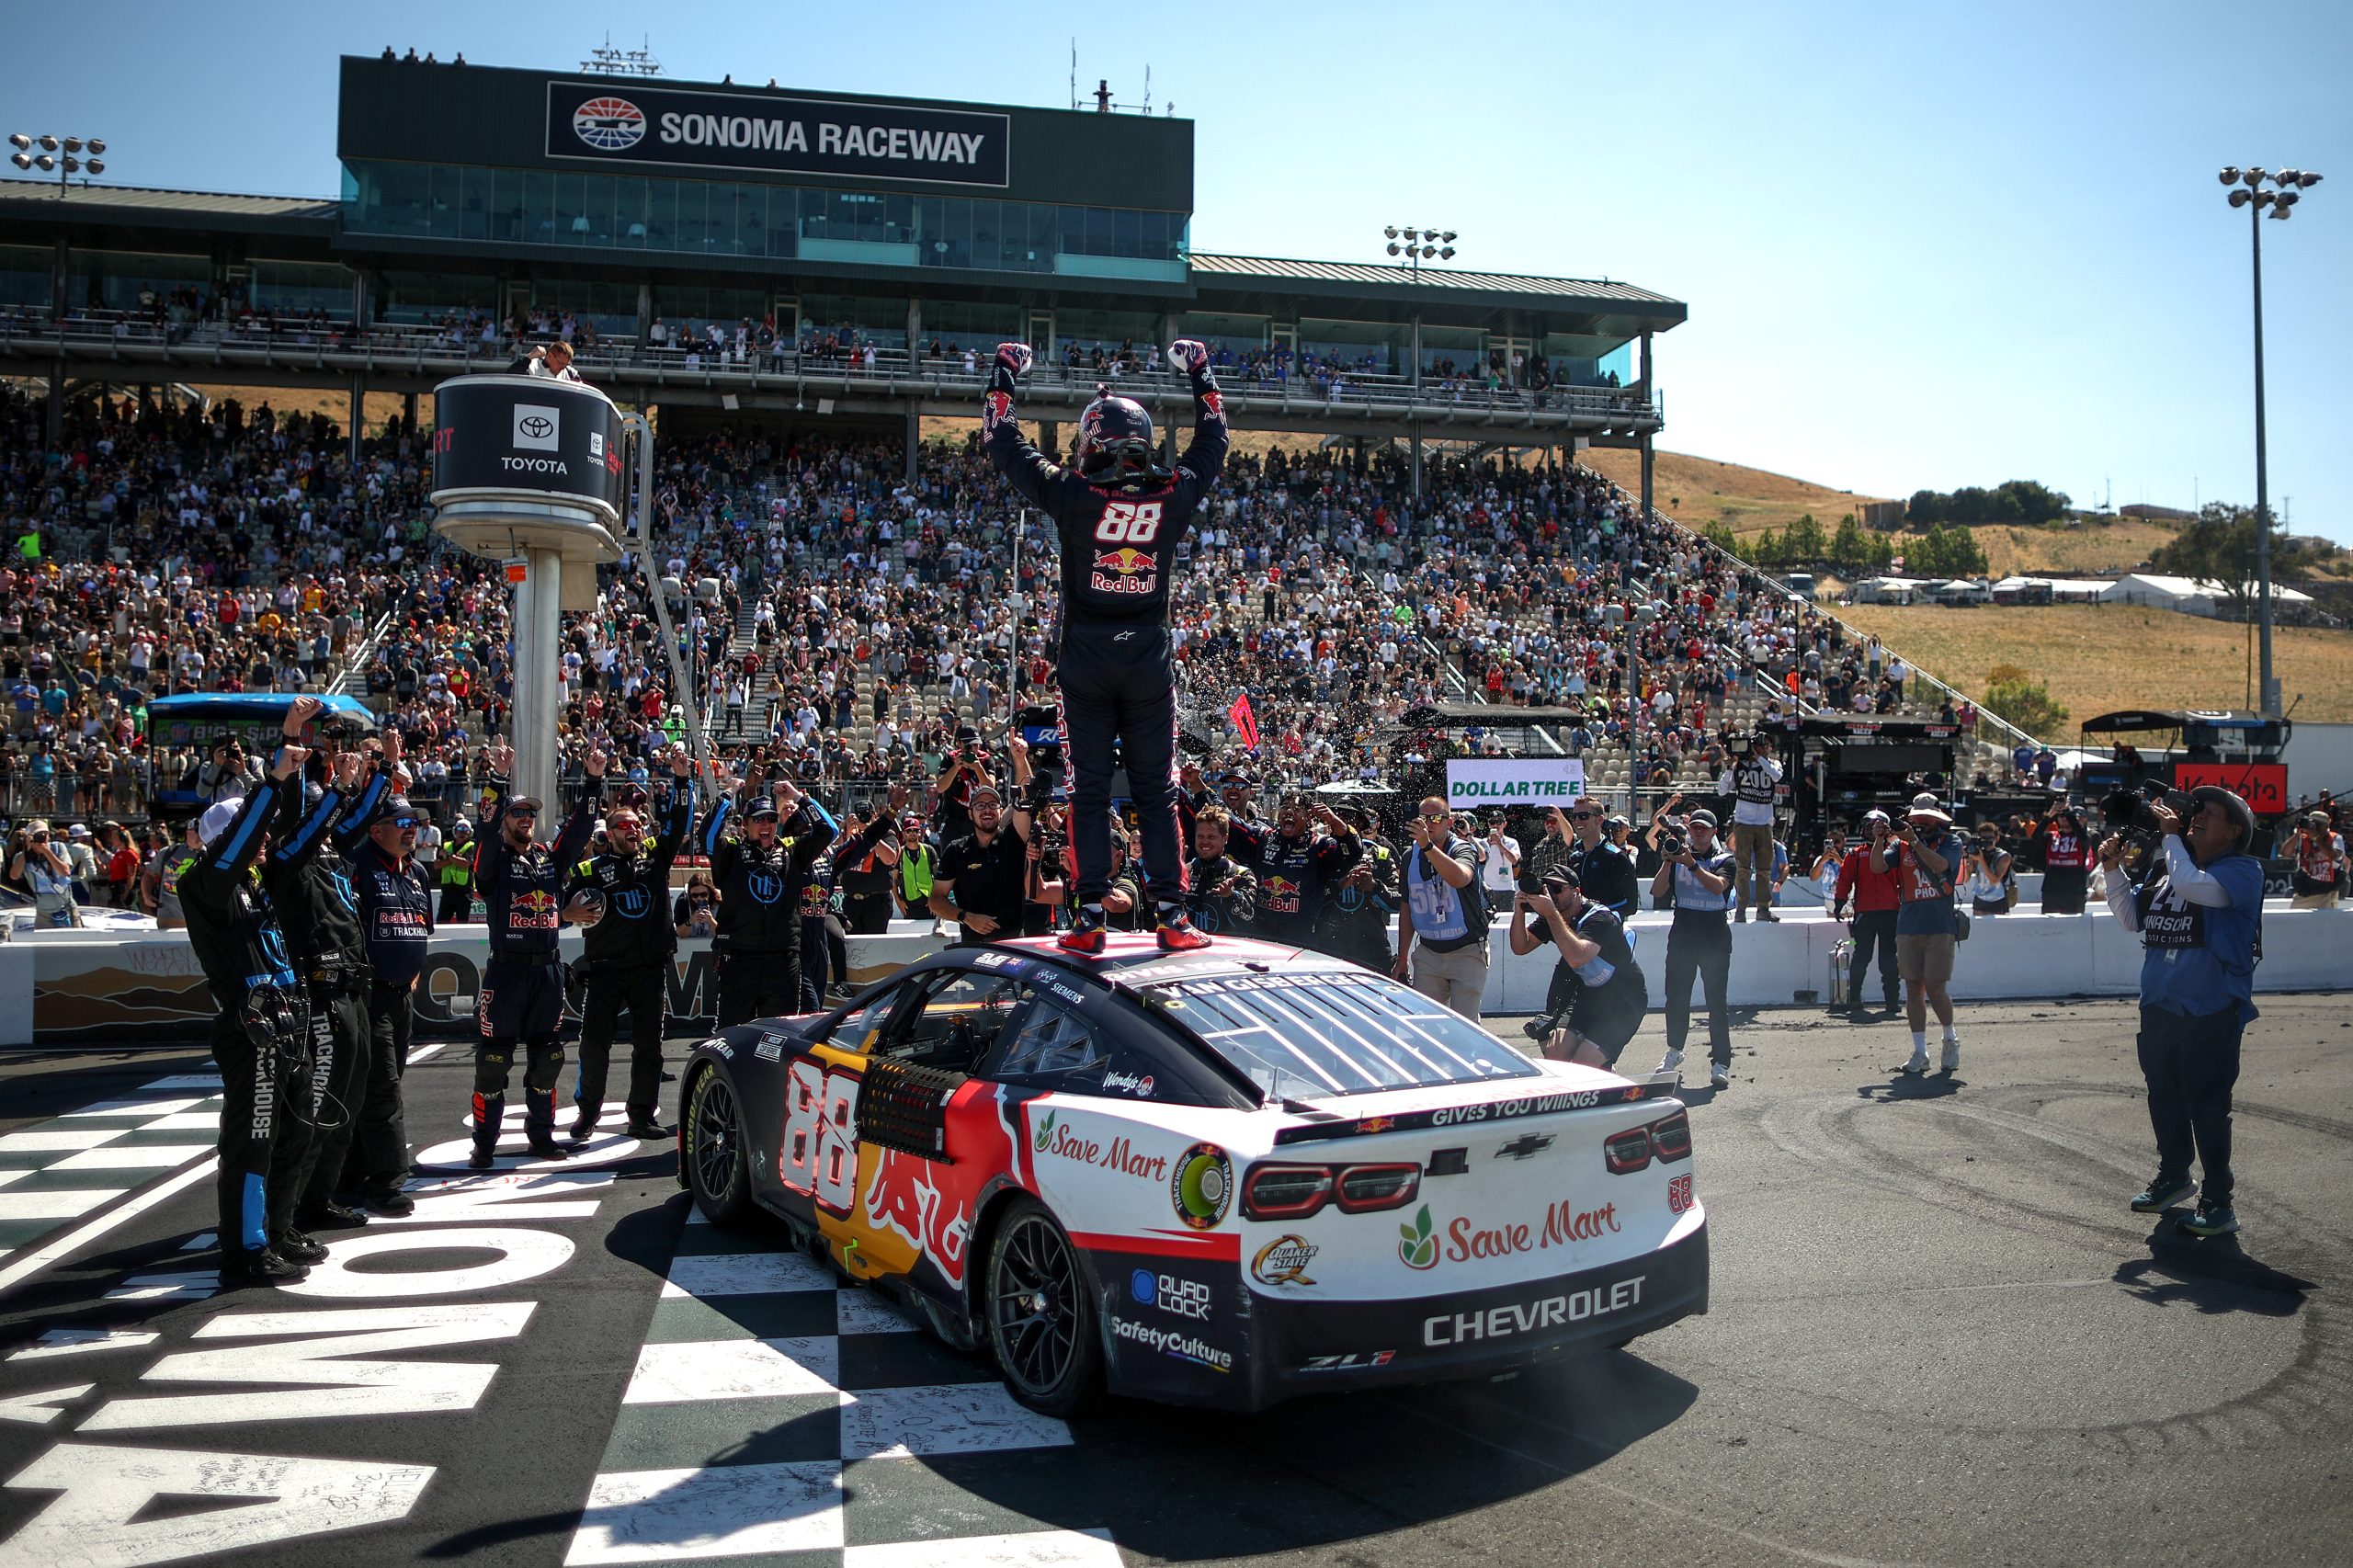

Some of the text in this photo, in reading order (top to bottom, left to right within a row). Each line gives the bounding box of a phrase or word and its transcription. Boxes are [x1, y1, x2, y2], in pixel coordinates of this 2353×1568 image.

[660, 110, 984, 165] SONOMA RACEWAY
[501, 457, 568, 475] TOYOTA
[587, 455, 604, 467] TOYOTA
[1094, 500, 1164, 543] 88
[1091, 572, 1155, 594] Red Bull
[1451, 780, 1580, 797] DOLLAR TREE
[1738, 769, 1772, 789] 206
[1745, 788, 1772, 797] NASCAR
[1915, 886, 1939, 899] PHO
[801, 903, 814, 917] ed
[1274, 897, 1299, 914] Bull
[381, 912, 397, 924] Red
[509, 911, 559, 929] Red Bull
[394, 926, 428, 937] TRACKHOU
[1051, 982, 1085, 1006] SIEMENS
[1154, 980, 1227, 999] VAN
[1103, 1071, 1139, 1092] Wendy's
[1432, 1103, 1487, 1126] GIVES
[1494, 1098, 1532, 1116] YOU
[781, 1056, 860, 1219] 88
[1051, 1123, 1167, 1182] Save Mart
[1173, 1152, 1192, 1212] TRACKHOUSE
[1214, 1160, 1232, 1221] TRACKHOUSE
[1668, 1173, 1694, 1215] 88
[1446, 1199, 1621, 1264] Save Mart
[1268, 1245, 1319, 1260] QUAKER
[1273, 1256, 1310, 1269] STATE
[1158, 1274, 1210, 1303] QUAD
[1158, 1291, 1210, 1322] LOCK
[1423, 1275, 1646, 1348] CHEVROLET
[1110, 1315, 1232, 1368] SafetyCulture
[1299, 1350, 1396, 1371] ZL1
